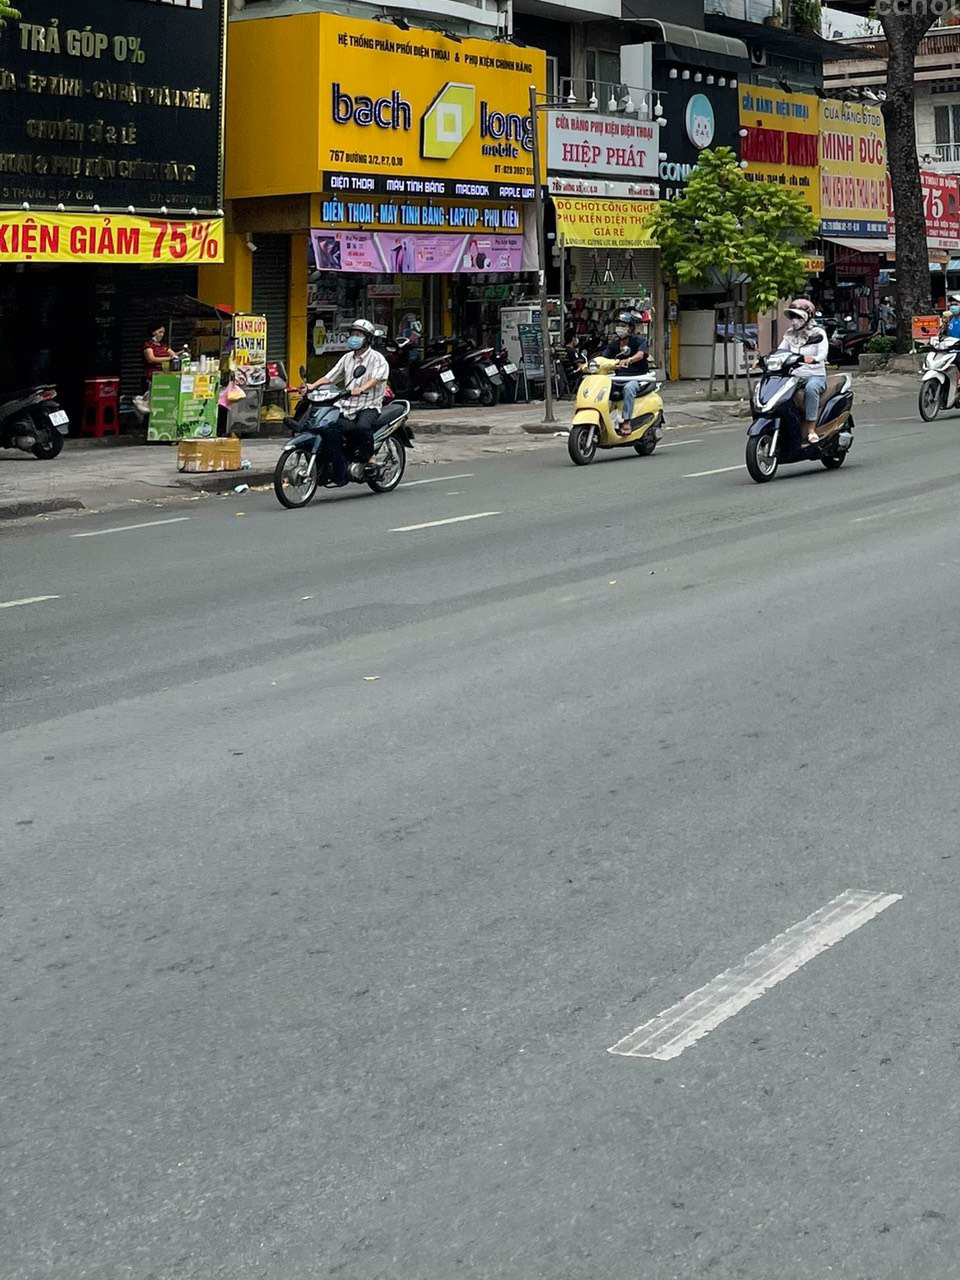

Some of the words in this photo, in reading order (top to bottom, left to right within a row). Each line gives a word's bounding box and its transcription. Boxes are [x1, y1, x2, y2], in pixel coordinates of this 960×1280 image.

[19, 18, 60, 54] TRẢ
[66, 26, 108, 59] GÓP
[114, 35, 145, 64] 0%
[338, 32, 348, 47] HỆ
[349, 33, 373, 49] THỐNG
[454, 52, 460, 62] &
[332, 82, 411, 131] bach
[480, 101, 534, 152] long
[330, 150, 344, 161] 767
[482, 144, 519, 158] mobile
[562, 140, 601, 167] HIỆP
[606, 144, 647, 167] PHÁT
[822, 133, 854, 161] MINH
[859, 132, 883, 165] ĐỨC
[331, 176, 349, 189] ĐIỆN
[351, 177, 375, 191] THOẠI
[386, 179, 404, 191] MÁY
[406, 179, 423, 192] TÍNH
[424, 180, 445, 193] BẢNG
[455, 184, 489, 196] MACBOOK
[499, 186, 520, 197] APPLE
[521, 188, 544, 199] WATH
[323, 198, 344, 225] ĐIỆN
[347, 202, 375, 226] THOẠI
[380, 200, 398, 224] MÁY
[401, 201, 420, 224] TÍNH
[422, 200, 445, 224] BẢNG
[449, 208, 479, 226] LAPTOP
[484, 209, 500, 231] PHỤ
[602, 201, 628, 212] CÔNG
[922, 187, 943, 218] 75
[578, 213, 602, 224] KIỆN
[604, 213, 628, 224] ĐIỆN
[630, 216, 645, 224] THO
[70, 217, 140, 255] GIẢM
[150, 222, 218, 259] 75%
